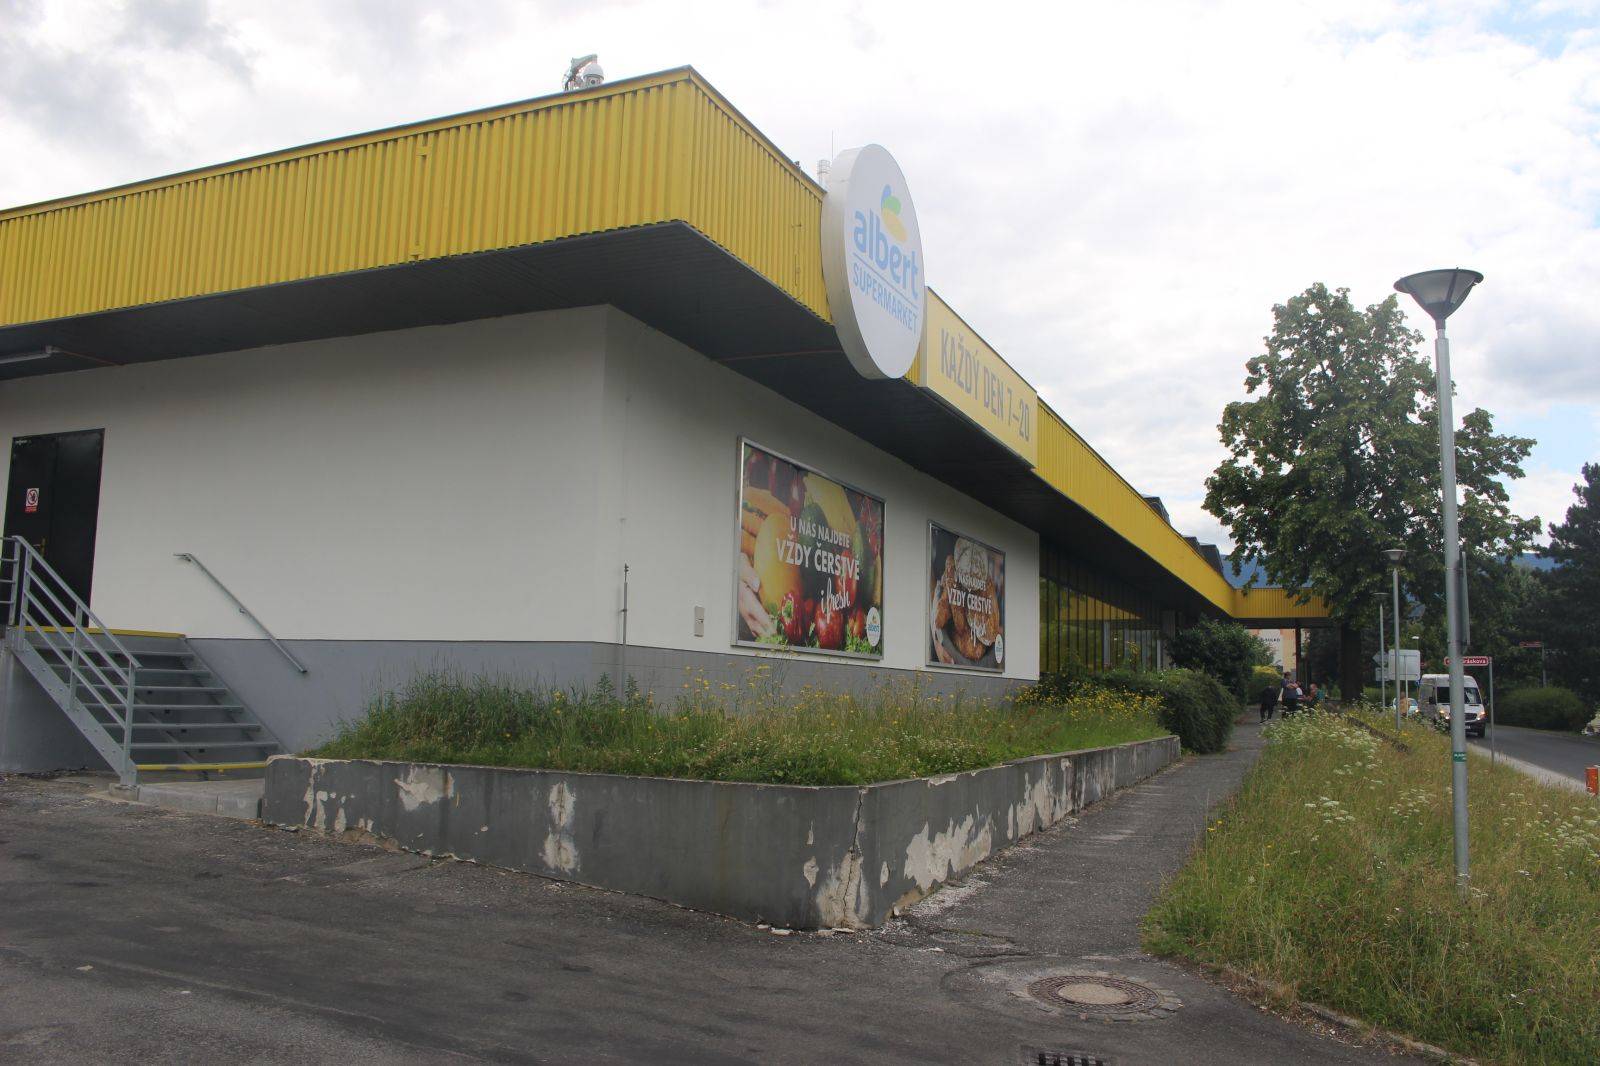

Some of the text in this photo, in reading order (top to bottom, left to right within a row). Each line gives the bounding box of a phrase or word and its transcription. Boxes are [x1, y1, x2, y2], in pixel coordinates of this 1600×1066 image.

[853, 207, 919, 299] albert
[853, 262, 918, 335] SUPERMARKET
[941, 328, 980, 401] KAŽDÝ
[983, 366, 1004, 420] DEN
[790, 516, 850, 548] U NÁS NAJDETE
[776, 534, 860, 580] VŽDY ČERSTVÉ
[826, 576, 850, 624] fresh
[947, 583, 992, 615] VŽDY ČERSTVÉ
